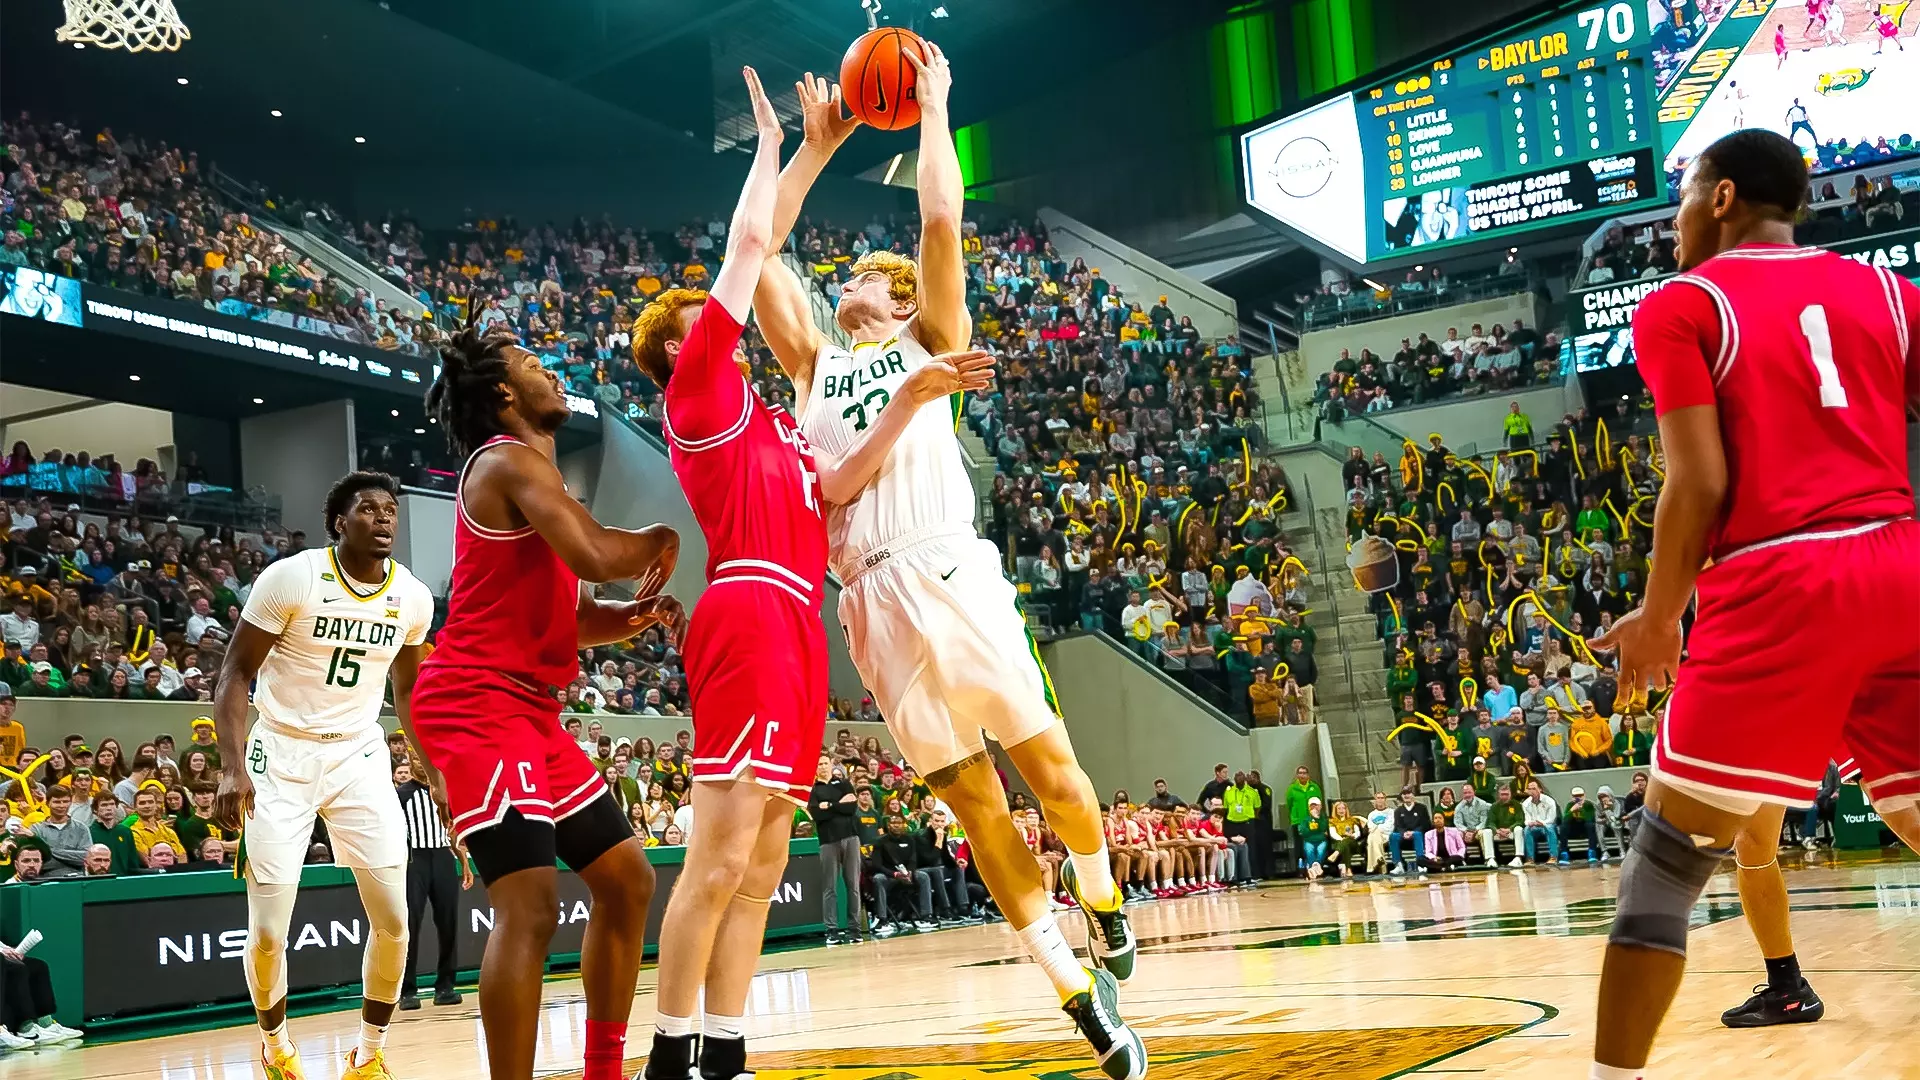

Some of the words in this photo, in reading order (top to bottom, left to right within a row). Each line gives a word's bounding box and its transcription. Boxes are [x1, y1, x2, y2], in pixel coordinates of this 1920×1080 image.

[1577, 2, 1635, 51] 70
[1490, 32, 1568, 71] BAYLOR
[1439, 73, 1448, 86] 2
[1388, 120, 1396, 132] 1
[1406, 109, 1447, 129] LITTLE
[1548, 83, 1556, 95] 1
[1583, 75, 1592, 87] 3
[1621, 66, 1629, 79] 1
[1550, 99, 1557, 111] 1
[1623, 83, 1631, 95] 1
[1409, 140, 1440, 157] LOVE
[1551, 114, 1559, 126] 1
[1624, 97, 1634, 110] 2
[1517, 136, 1527, 149] 2
[1553, 129, 1560, 141] 1
[1626, 113, 1634, 125] 1
[1627, 129, 1637, 142] 2
[1267, 156, 1339, 178] NISSAN
[1465, 180, 1522, 203] THROW
[1524, 170, 1571, 192] SOME
[1466, 195, 1521, 217] SHADE
[1522, 186, 1563, 206] WITH
[1468, 215, 1490, 231] US
[1492, 207, 1529, 226] THIS
[1531, 199, 1583, 218] APRIL.
[86, 300, 133, 322] THROW
[133, 310, 168, 330] SOME
[168, 318, 208, 338] SHADE
[207, 326, 237, 345] WITH
[237, 333, 255, 348] US
[254, 336, 280, 354] THIS
[1584, 303, 1640, 330] PART
[1799, 304, 1849, 408] 1
[824, 350, 907, 399] BAYLOR
[864, 548, 891, 568] BEARS
[312, 616, 396, 647] BAYLOR
[325, 647, 367, 688] 15
[763, 720, 779, 757] C
[517, 761, 536, 793] C
[1842, 813, 1865, 824] Your
[158, 918, 361, 965] NISAN
